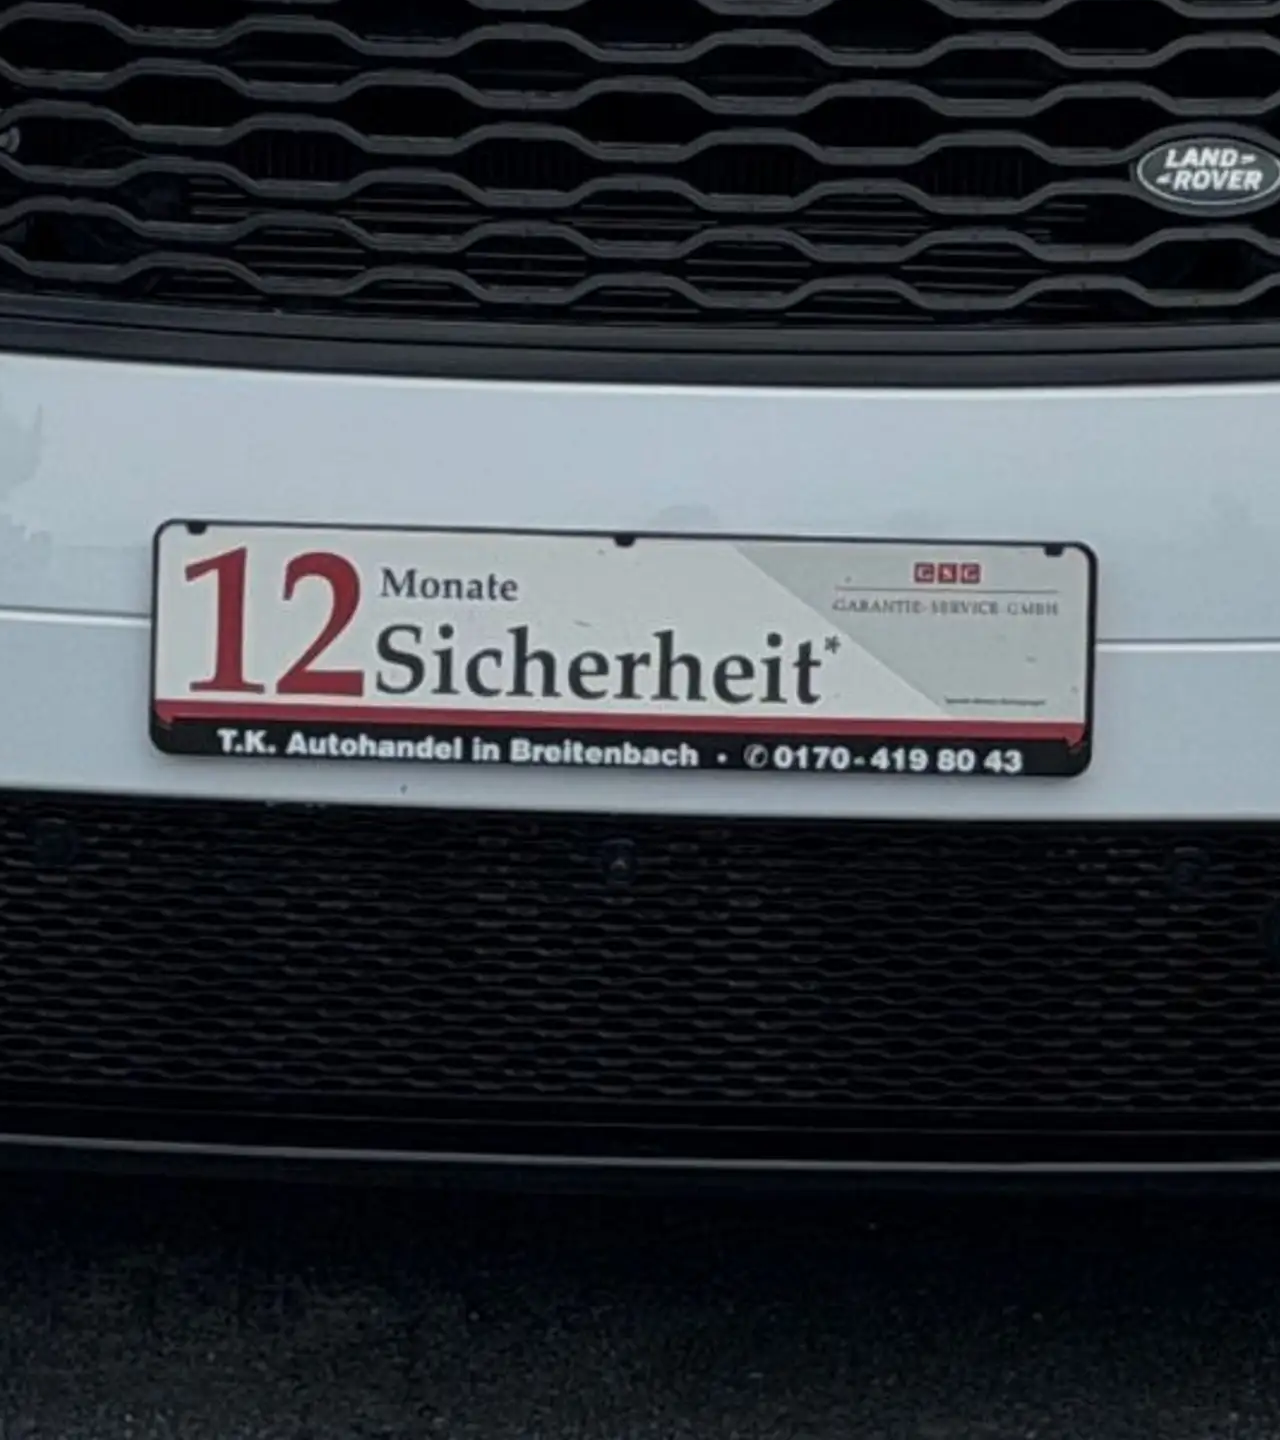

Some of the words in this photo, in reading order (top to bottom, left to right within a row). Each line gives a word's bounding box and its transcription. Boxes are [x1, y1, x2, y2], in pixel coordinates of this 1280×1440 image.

[379, 566, 520, 602] Monate
[184, 546, 365, 698] 12
[216, 728, 277, 755] T.K.
[285, 731, 463, 760] Autohandel
[471, 737, 500, 762] in
[509, 738, 699, 768] Breitenbach
[937, 749, 975, 772] 80
[982, 749, 1024, 774] 43
